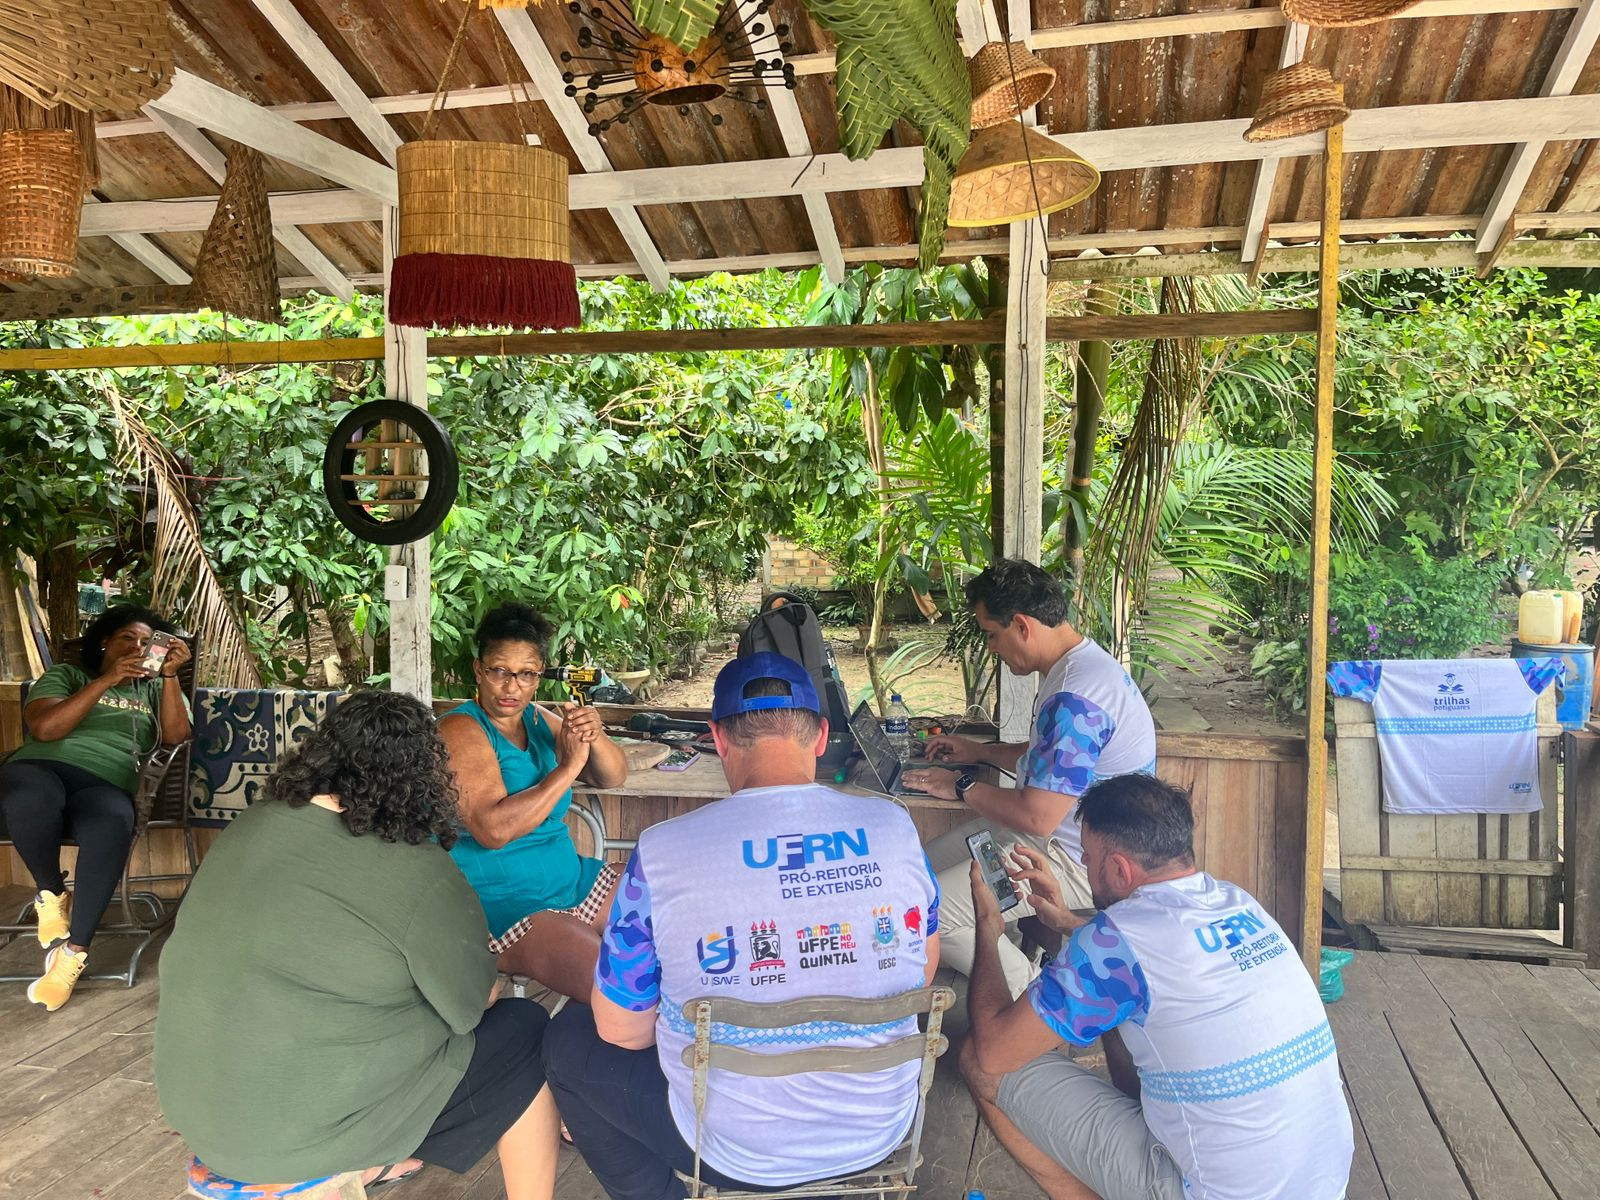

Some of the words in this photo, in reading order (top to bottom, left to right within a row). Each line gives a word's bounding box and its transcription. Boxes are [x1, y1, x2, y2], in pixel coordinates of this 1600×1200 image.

[1434, 696, 1470, 705] trilhas
[1434, 704, 1470, 712] potiguares
[742, 827, 870, 871] UFRN
[779, 862, 881, 885] PRÓ-REITORIA
[782, 886, 802, 899] DE
[806, 875, 882, 897] EXTENSÃO
[1194, 908, 1266, 953] UFRN
[799, 936, 839, 953] UFPE
[1230, 931, 1280, 961] PRÓ-REITORIA
[799, 951, 858, 969] QUINTAL
[878, 957, 896, 970] UESC
[1238, 961, 1253, 972] DE
[1254, 943, 1287, 966] EXTENSÃO
[750, 973, 786, 986] UFPE
